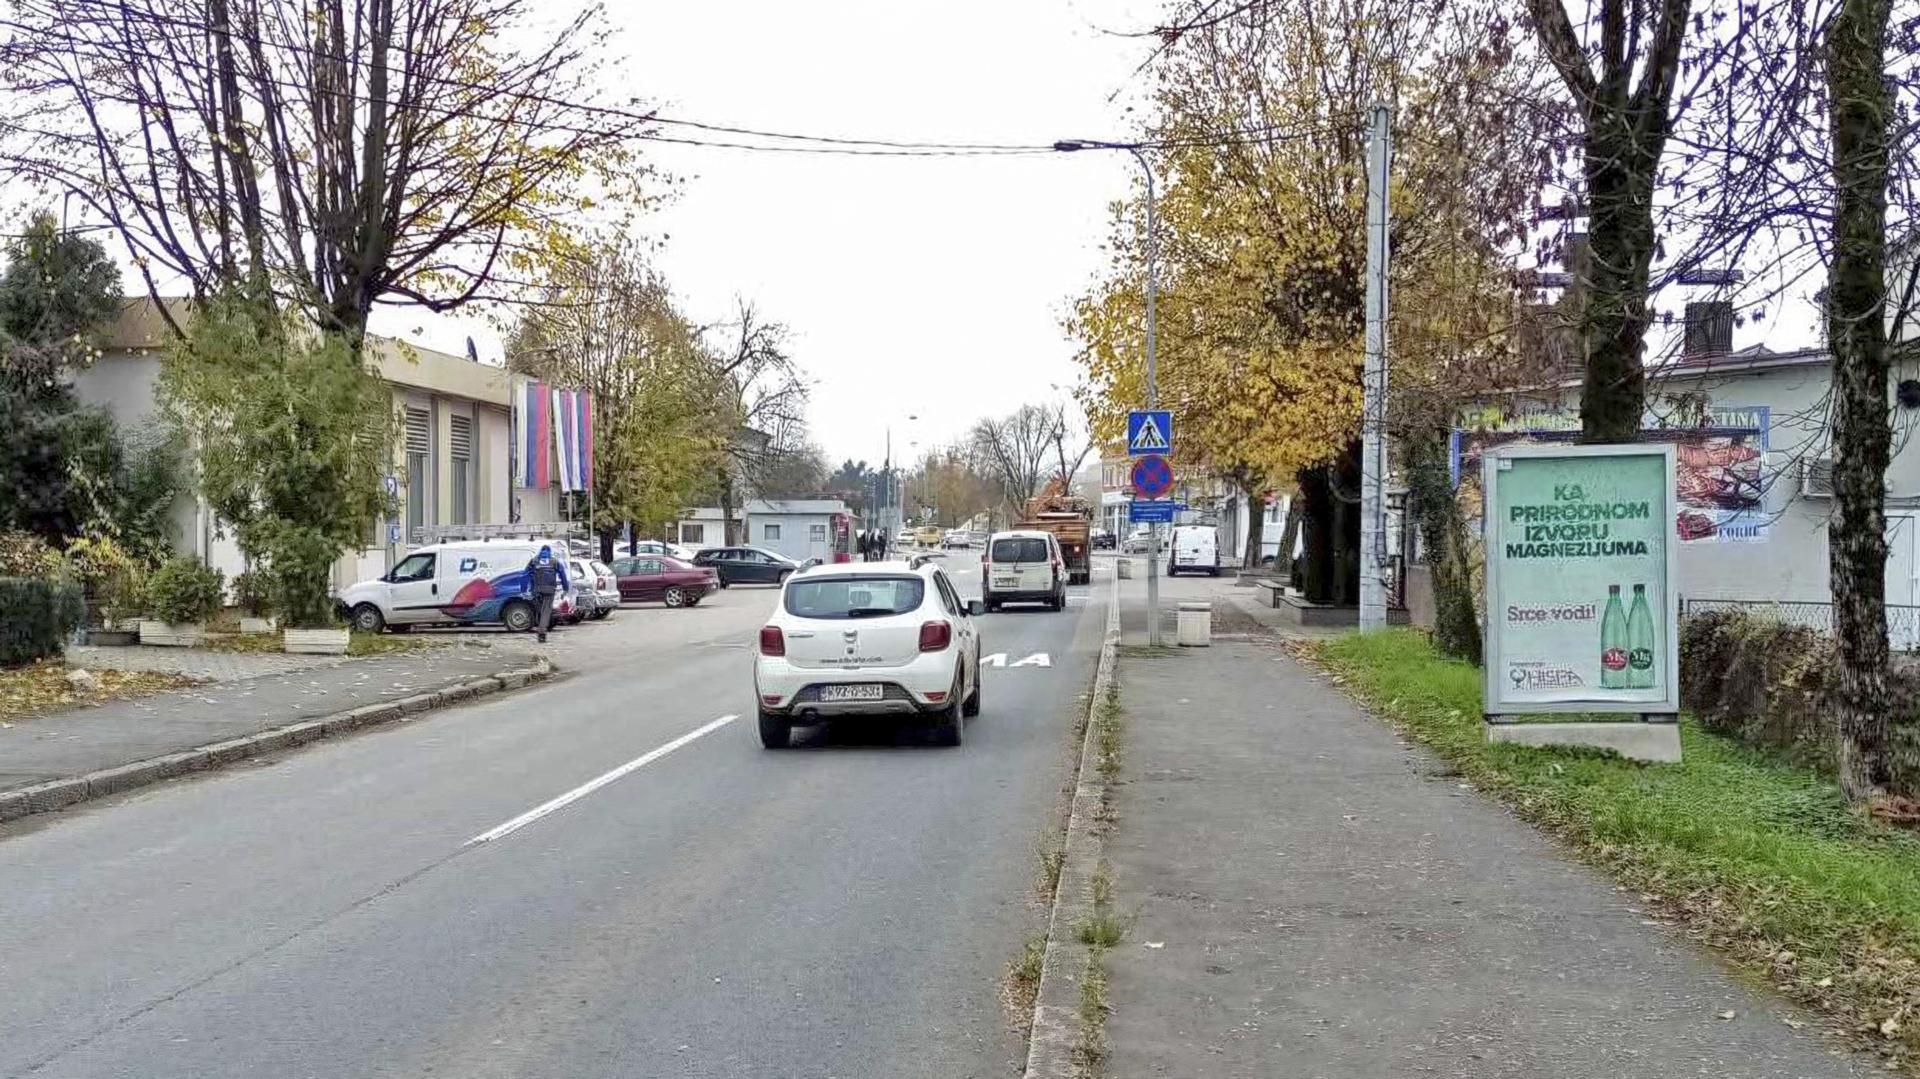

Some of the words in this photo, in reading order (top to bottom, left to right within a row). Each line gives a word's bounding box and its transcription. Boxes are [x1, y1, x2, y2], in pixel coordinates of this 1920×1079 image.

[1554, 485, 1583, 501] KA
[1510, 502, 1650, 522] PRIRODNOM
[1525, 524, 1608, 541] IZVORU
[1506, 541, 1649, 558] MAGNEZIJUMA
[1507, 605, 1548, 622] Srce
[1551, 604, 1596, 621] vodi!
